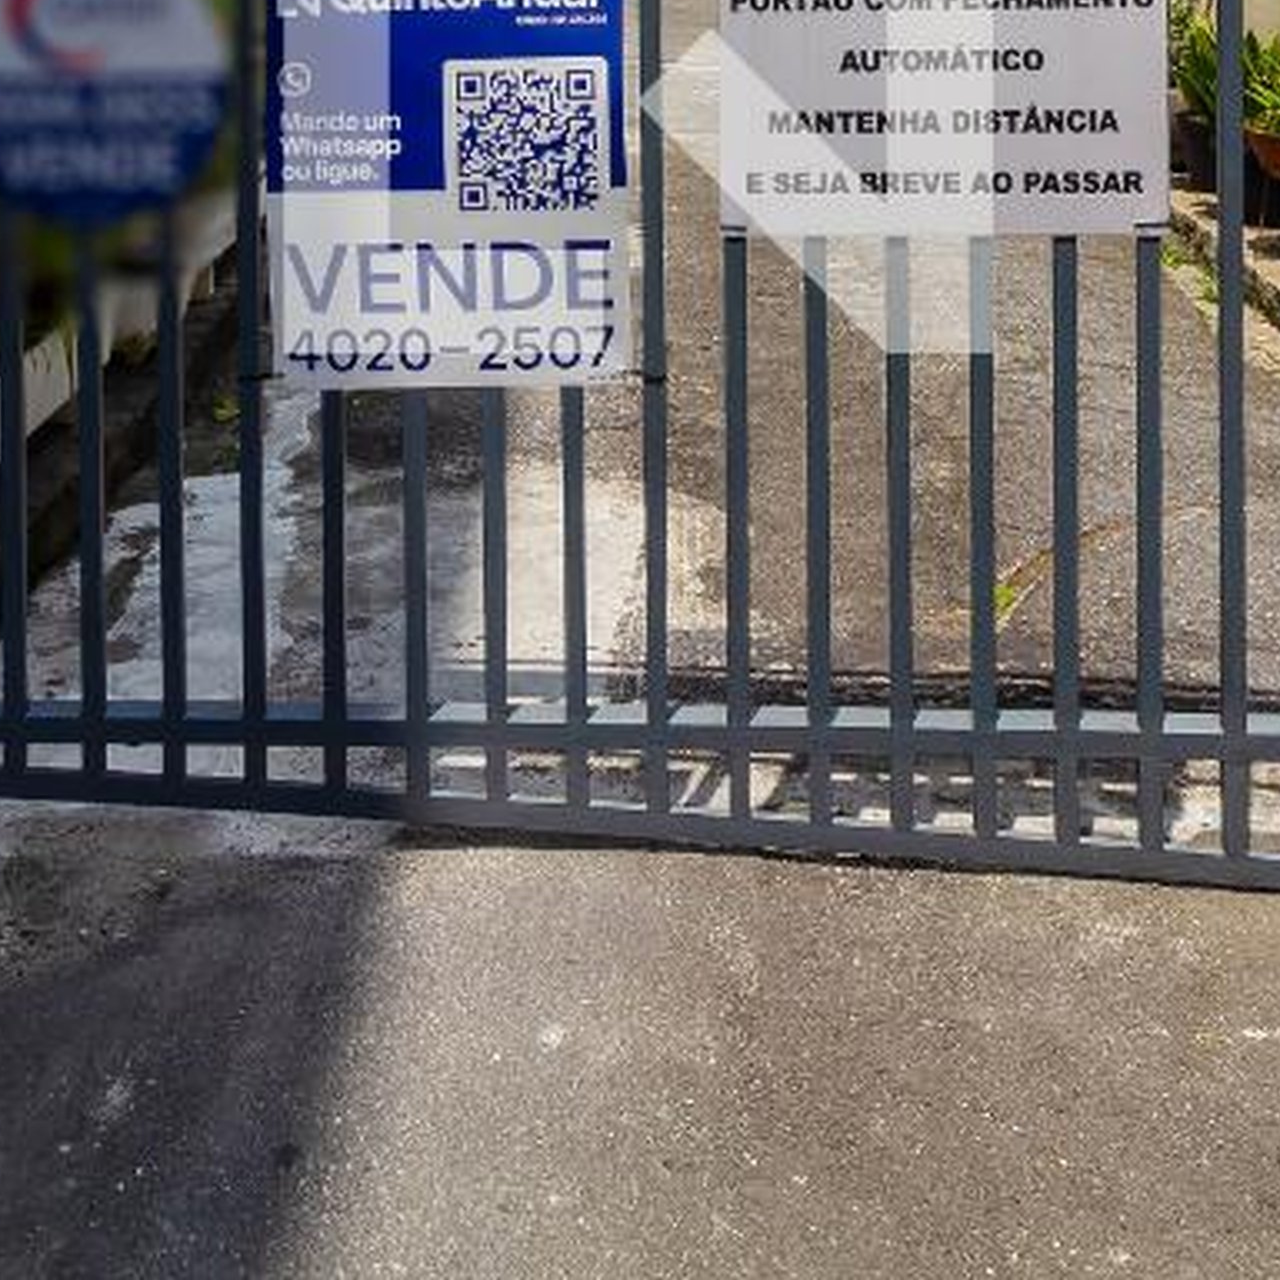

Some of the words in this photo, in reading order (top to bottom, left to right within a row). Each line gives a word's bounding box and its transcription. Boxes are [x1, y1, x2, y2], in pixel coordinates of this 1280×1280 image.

[839, 45, 1045, 74] AUTOMÁTICO
[364, 115, 402, 131] um
[767, 109, 941, 135] MANTENHA
[952, 103, 1120, 135] DISTÂNCIA
[279, 136, 402, 161] Whatsapp
[282, 164, 311, 182] ou
[315, 159, 379, 186] ligue.
[745, 171, 764, 194] E
[772, 171, 850, 195] SEJA
[859, 171, 961, 195] BREVE
[970, 171, 1013, 195] AO
[1022, 170, 1145, 195] PASSAR
[286, 239, 614, 314] VENDE
[287, 325, 615, 371] 4020-2507
